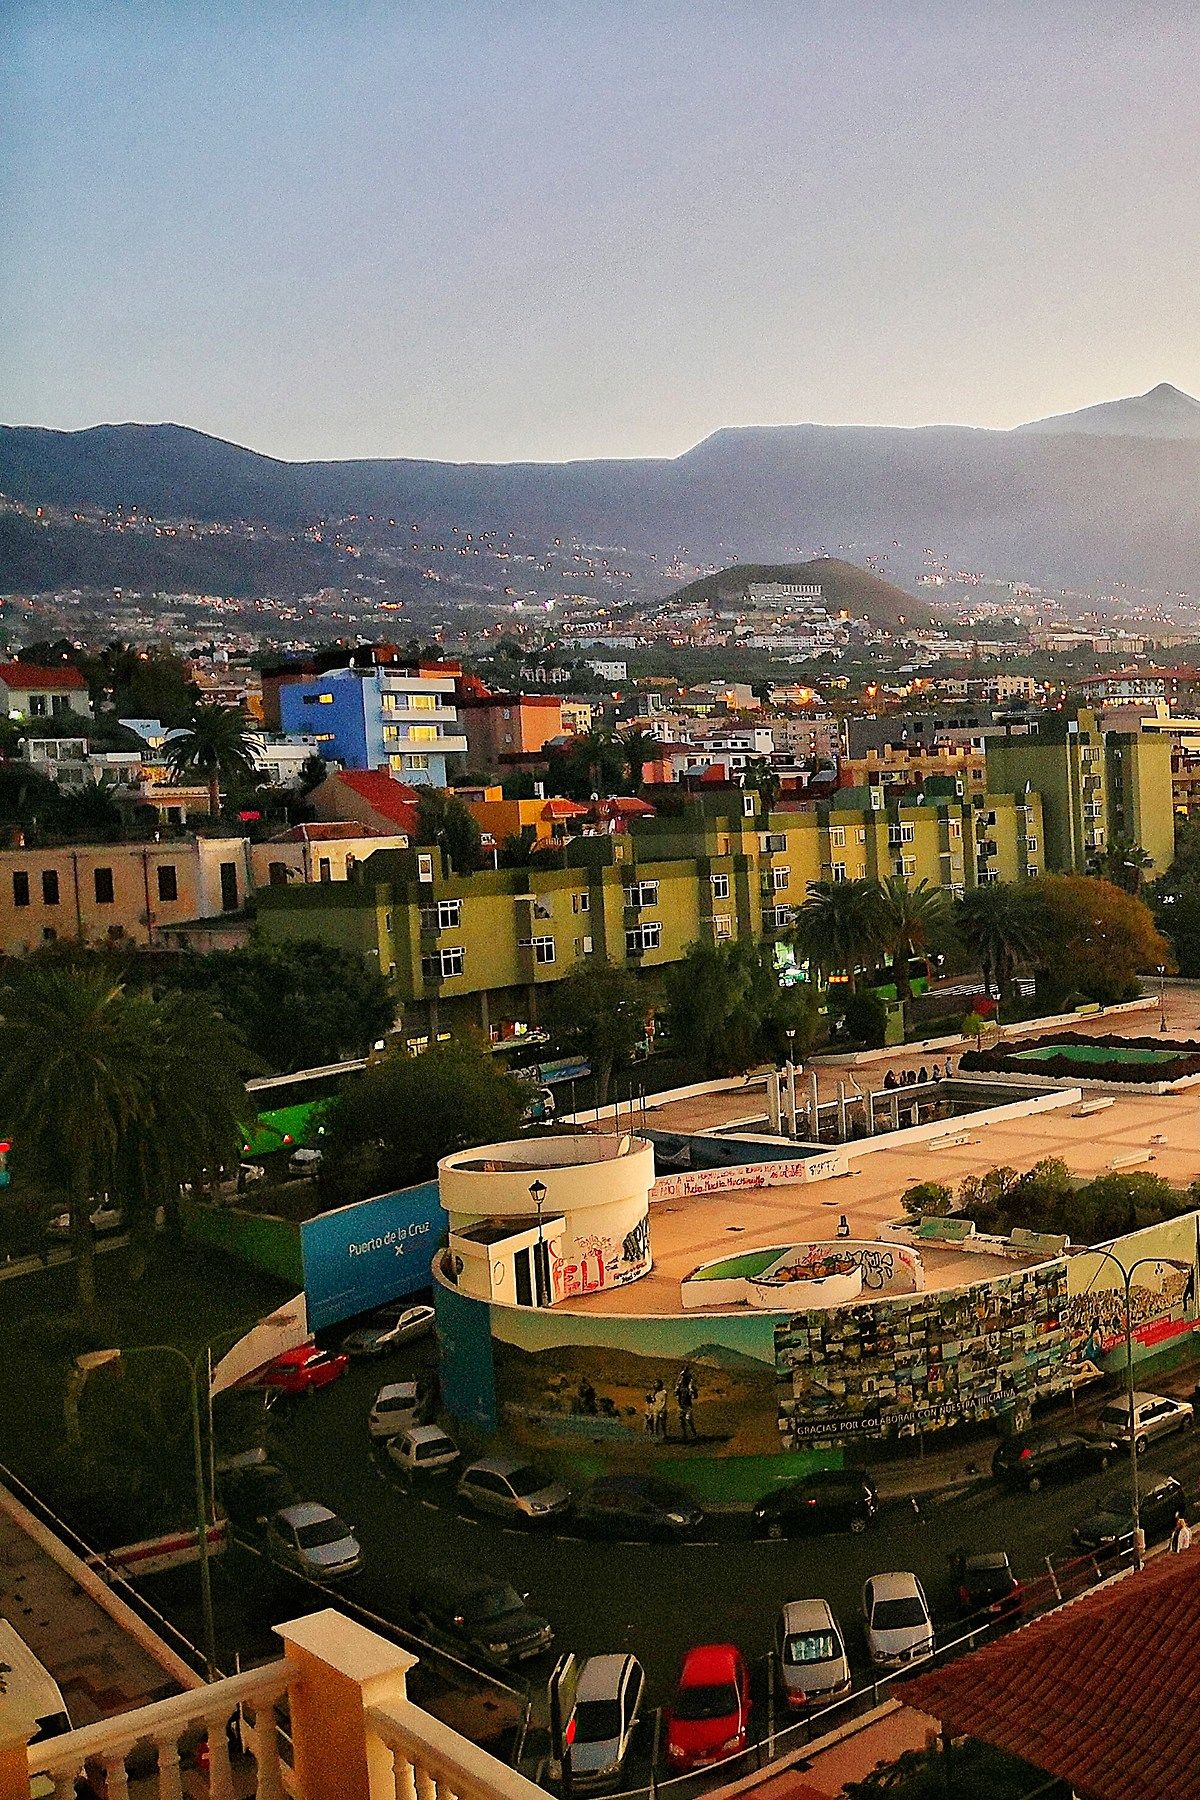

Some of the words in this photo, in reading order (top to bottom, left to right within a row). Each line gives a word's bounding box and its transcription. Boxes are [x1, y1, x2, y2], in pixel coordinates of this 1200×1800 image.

[349, 1237, 383, 1257] Puerto
[384, 1230, 396, 1245] de
[397, 1227, 407, 1241] la
[409, 1222, 430, 1236] Cruz
[796, 1422, 838, 1436] GRACIAS
[840, 1420, 859, 1431] POR
[861, 1411, 916, 1428] COLABORAR
[917, 1407, 937, 1419] CON
[939, 1398, 976, 1414] NUESTRA
